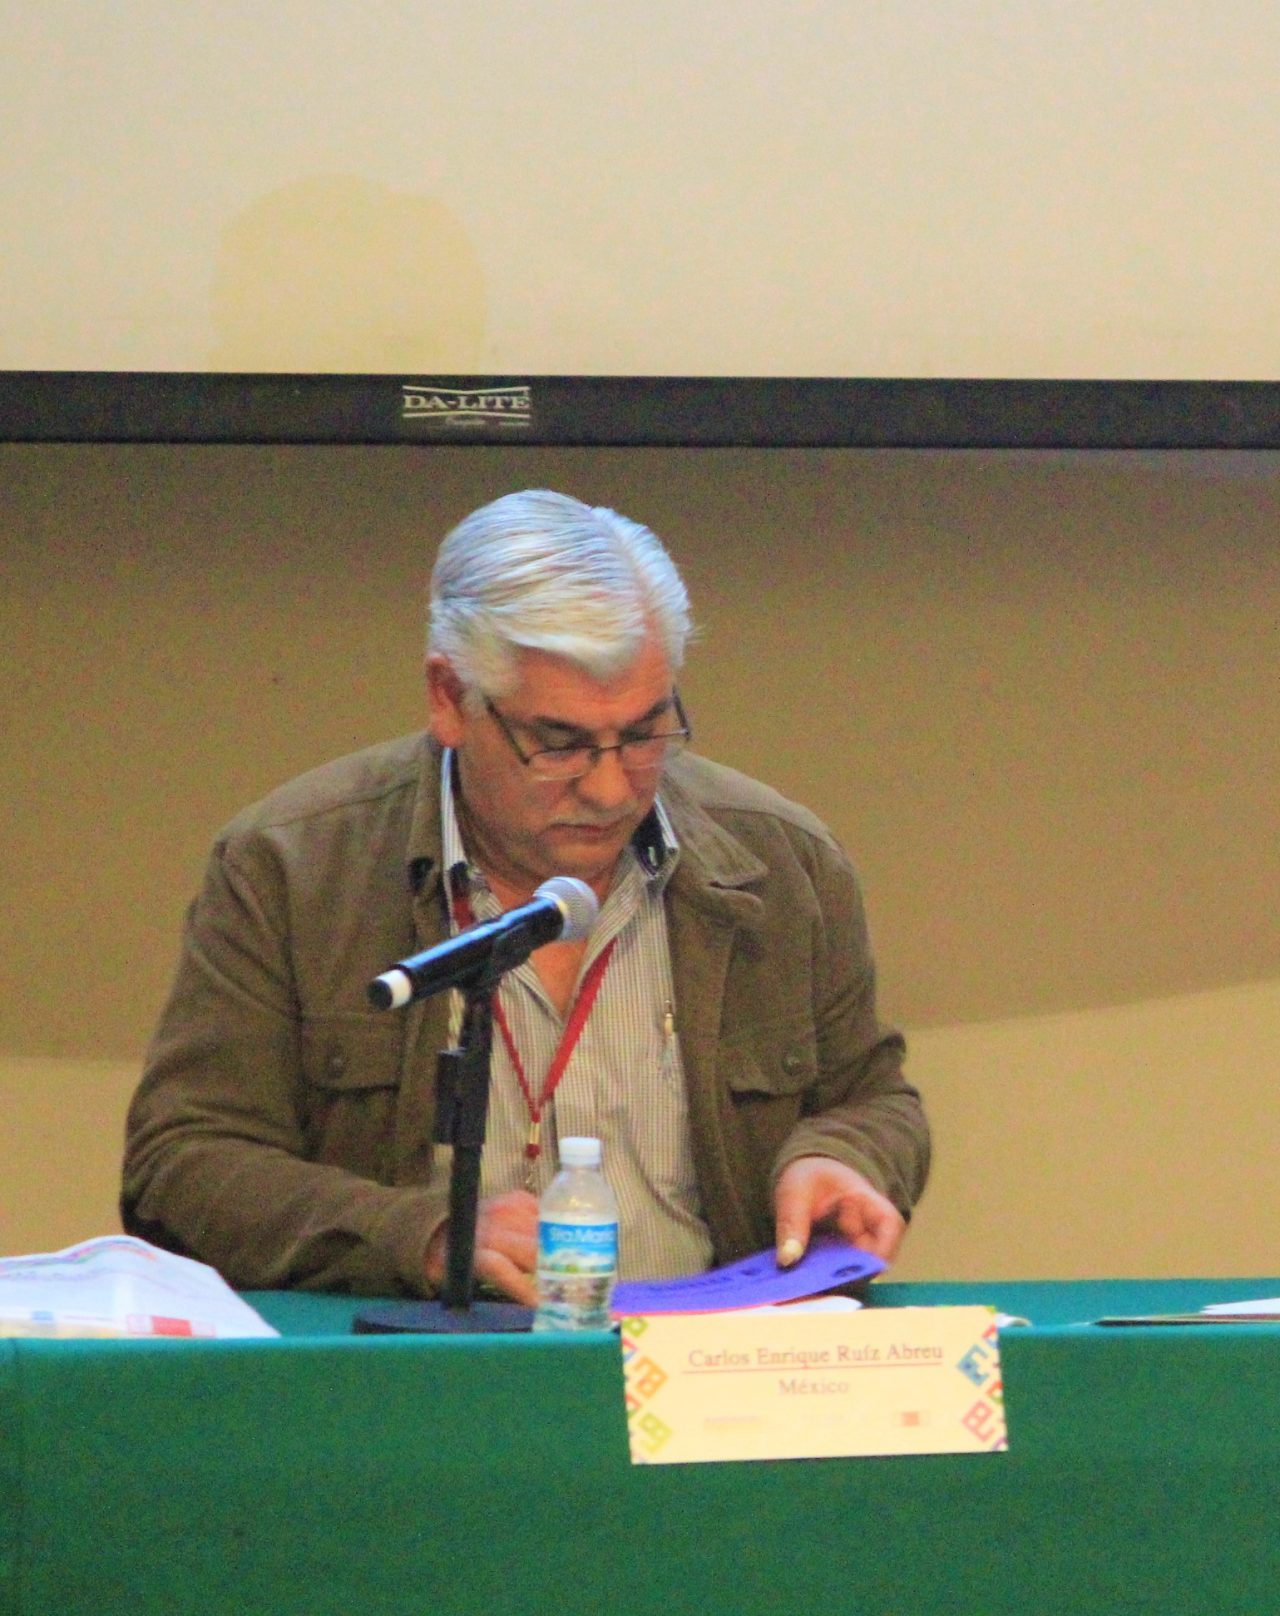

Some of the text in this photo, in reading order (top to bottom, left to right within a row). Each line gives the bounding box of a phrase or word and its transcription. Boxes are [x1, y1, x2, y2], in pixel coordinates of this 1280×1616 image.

[403, 394, 530, 409] DA-LITE
[688, 1348, 750, 1367] Carlos
[756, 1346, 830, 1370] Enrique
[887, 1341, 944, 1360] Abreu
[778, 1377, 849, 1396] México
